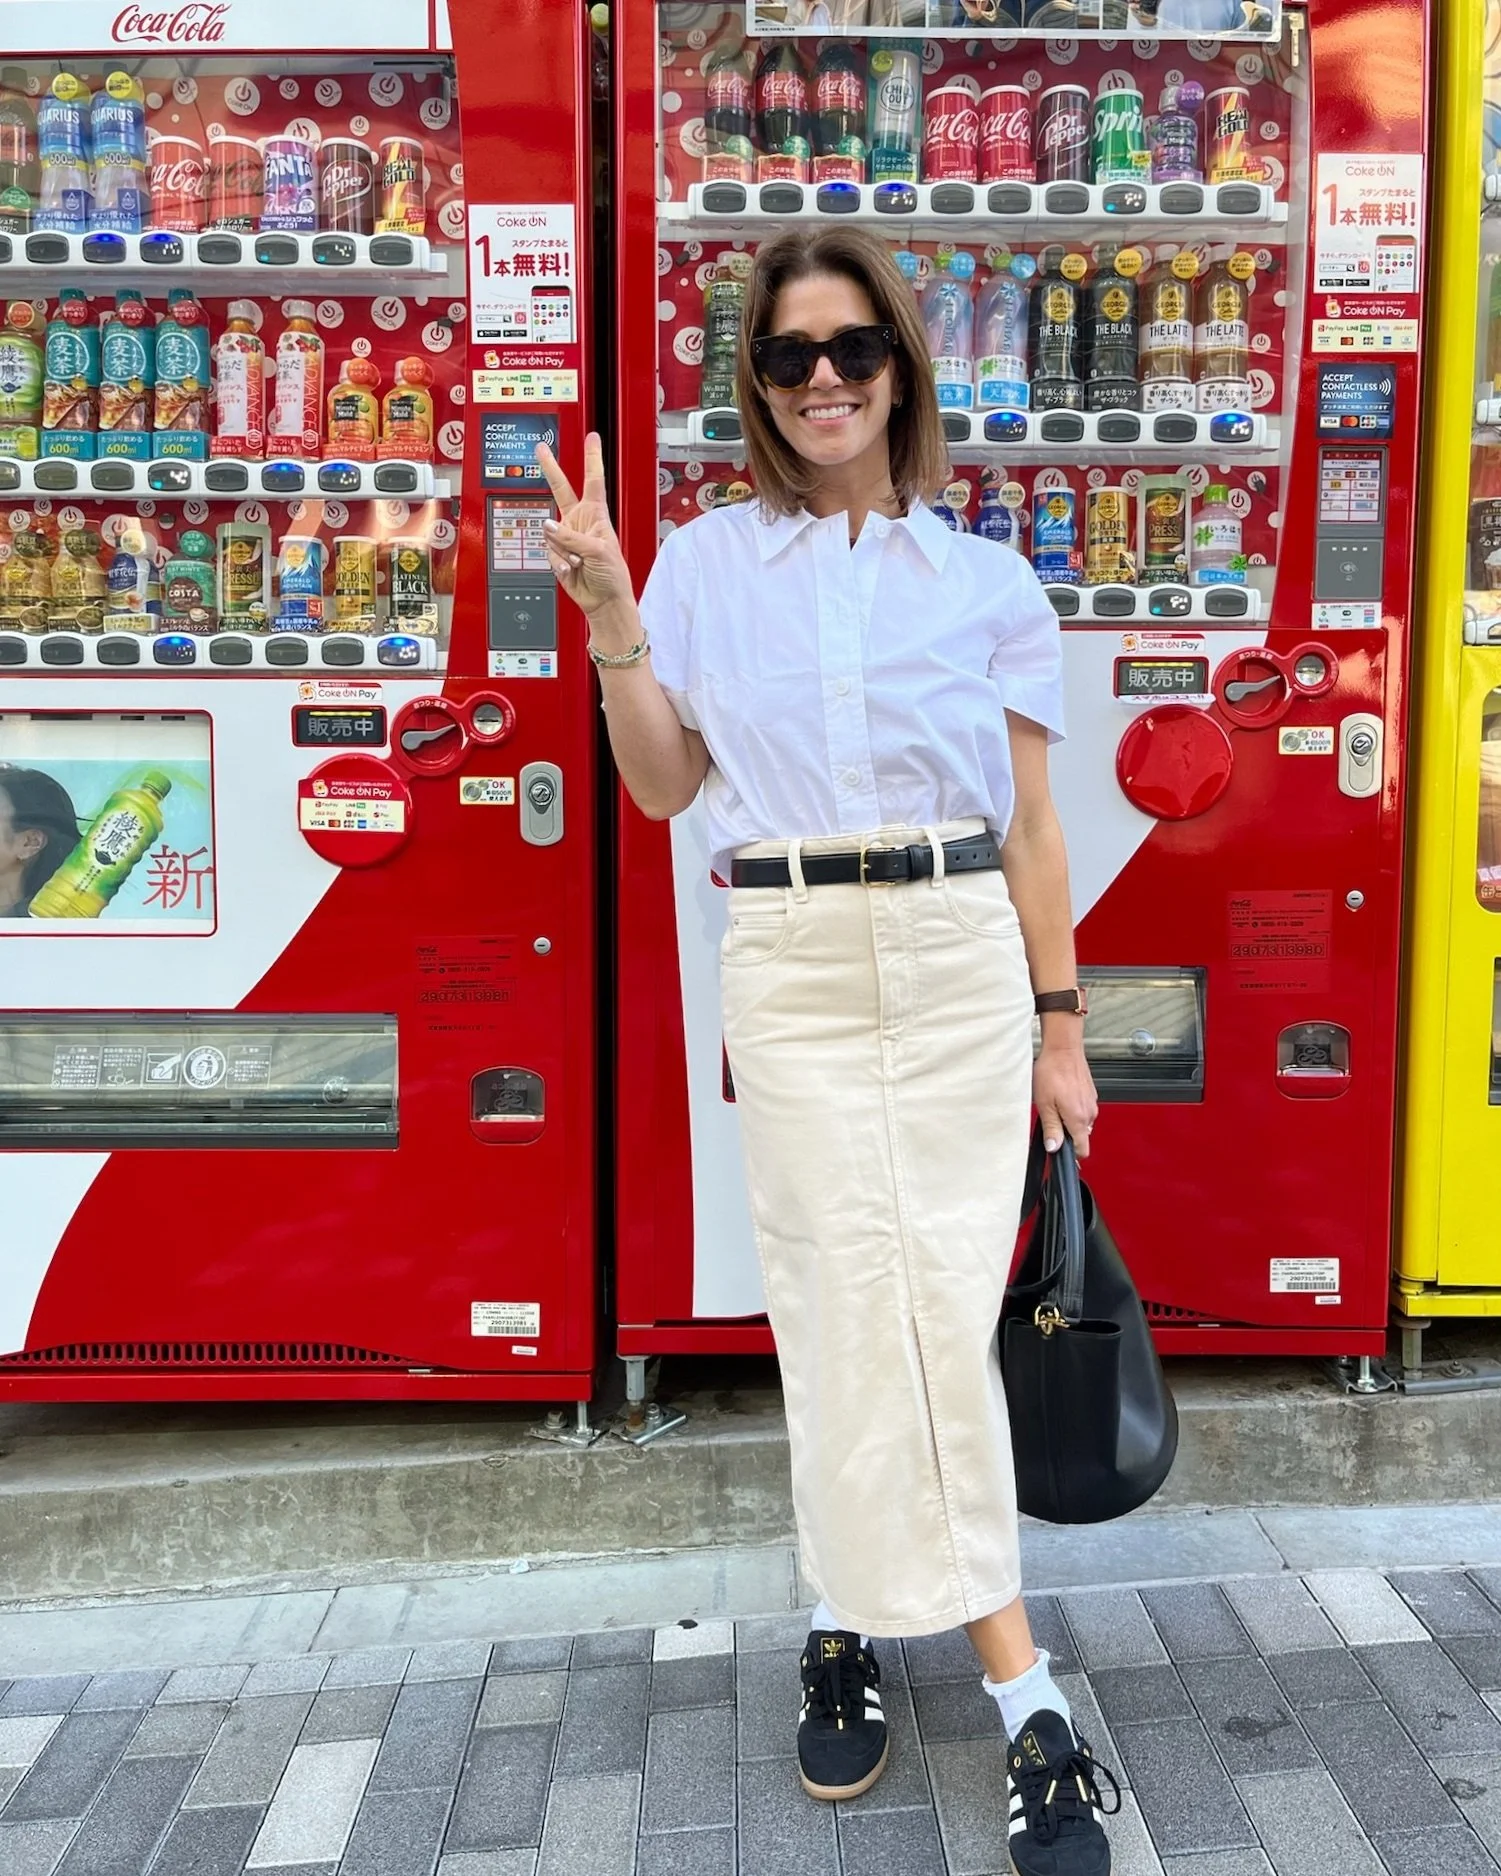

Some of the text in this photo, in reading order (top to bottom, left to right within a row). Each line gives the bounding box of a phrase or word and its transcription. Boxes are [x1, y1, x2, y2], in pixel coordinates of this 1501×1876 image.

[112, 4, 232, 43] Coca-Cola
[38, 108, 80, 124] QUARIUS
[91, 108, 134, 123] QUARIUS
[1059, 114, 1078, 130] Dr
[1045, 124, 1087, 151] Pepper
[332, 165, 351, 180] Dr
[1345, 165, 1395, 176] Coke ON
[323, 174, 364, 200] Pepper
[1359, 189, 1416, 197] スタンプたまると
[497, 216, 547, 227] Coke ON
[512, 240, 569, 248] スタンプたまると
[1343, 306, 1406, 318] Coke ON Pay
[1039, 324, 1078, 338] THE BLACK
[1096, 323, 1133, 335] THE BLACK
[1150, 324, 1188, 338] THE LATTE
[1206, 324, 1244, 338] THE LATTE
[54, 336, 74, 374] 麦茶
[110, 338, 131, 376] 麦茶
[164, 336, 184, 375] 麦茶
[502, 356, 565, 368] Coke ON Pay
[1321, 383, 1378, 391] CONTACTLESS
[485, 433, 541, 441] CONTACTLESS
[1089, 520, 1126, 534] GOLDEN
[392, 580, 428, 593] BLACK
[168, 590, 199, 598] COSTA
[1140, 639, 1200, 651] Coke ON Pay
[1128, 668, 1195, 688] 販売中
[318, 688, 377, 699] Coke ON Pay
[308, 717, 375, 737] 販売中
[1311, 731, 1325, 739] OK
[492, 781, 506, 789] OK
[330, 786, 392, 799] Coke ON Pay
[143, 844, 213, 909] 新
